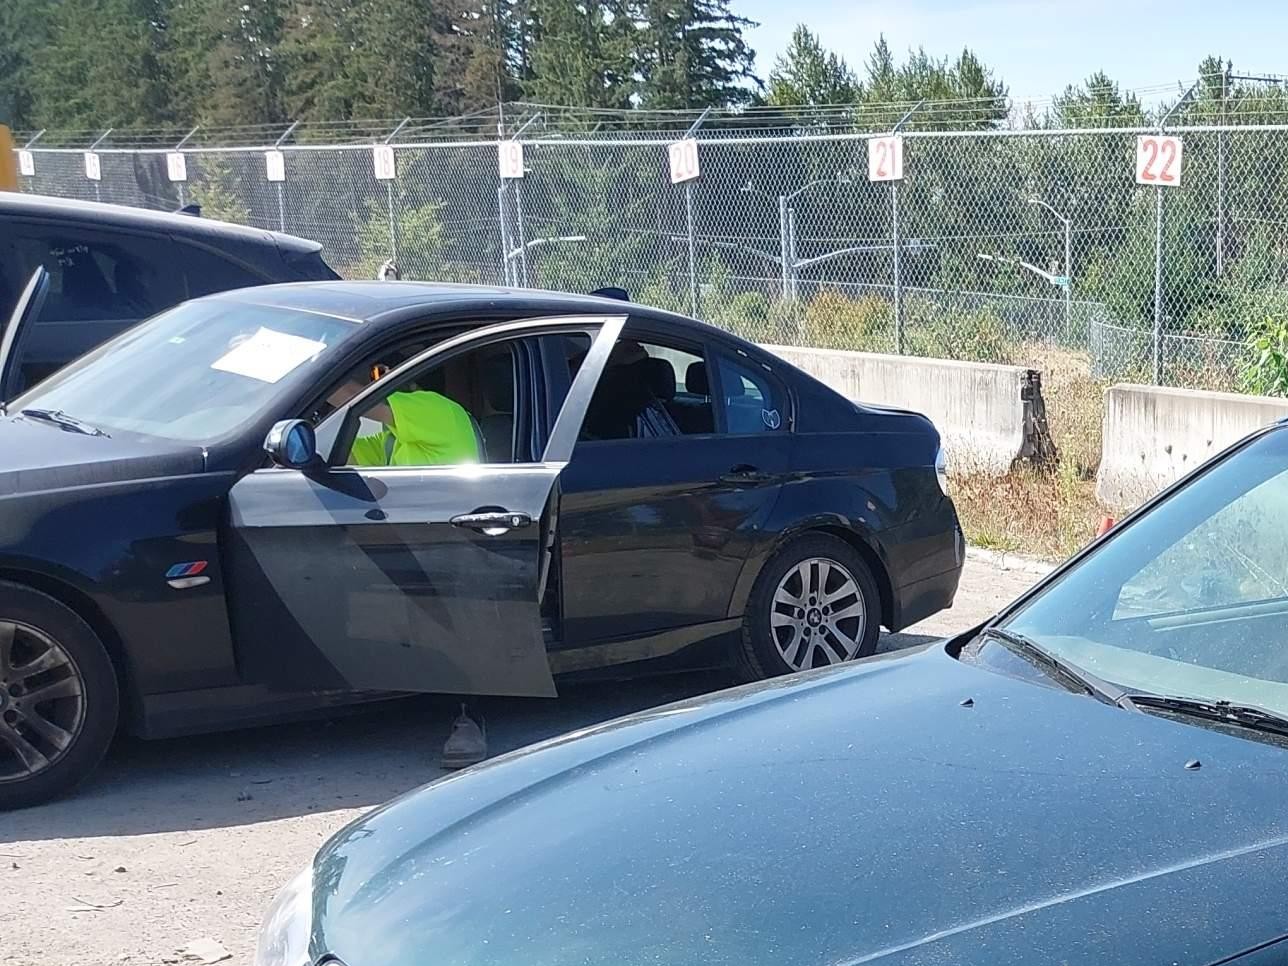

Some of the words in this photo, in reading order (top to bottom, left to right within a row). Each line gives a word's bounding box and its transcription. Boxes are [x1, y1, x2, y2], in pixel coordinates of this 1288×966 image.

[378, 149, 391, 176] 18
[504, 144, 519, 174] 19
[672, 143, 696, 178] 20
[875, 141, 896, 178] 21
[1141, 139, 1176, 181] 22
